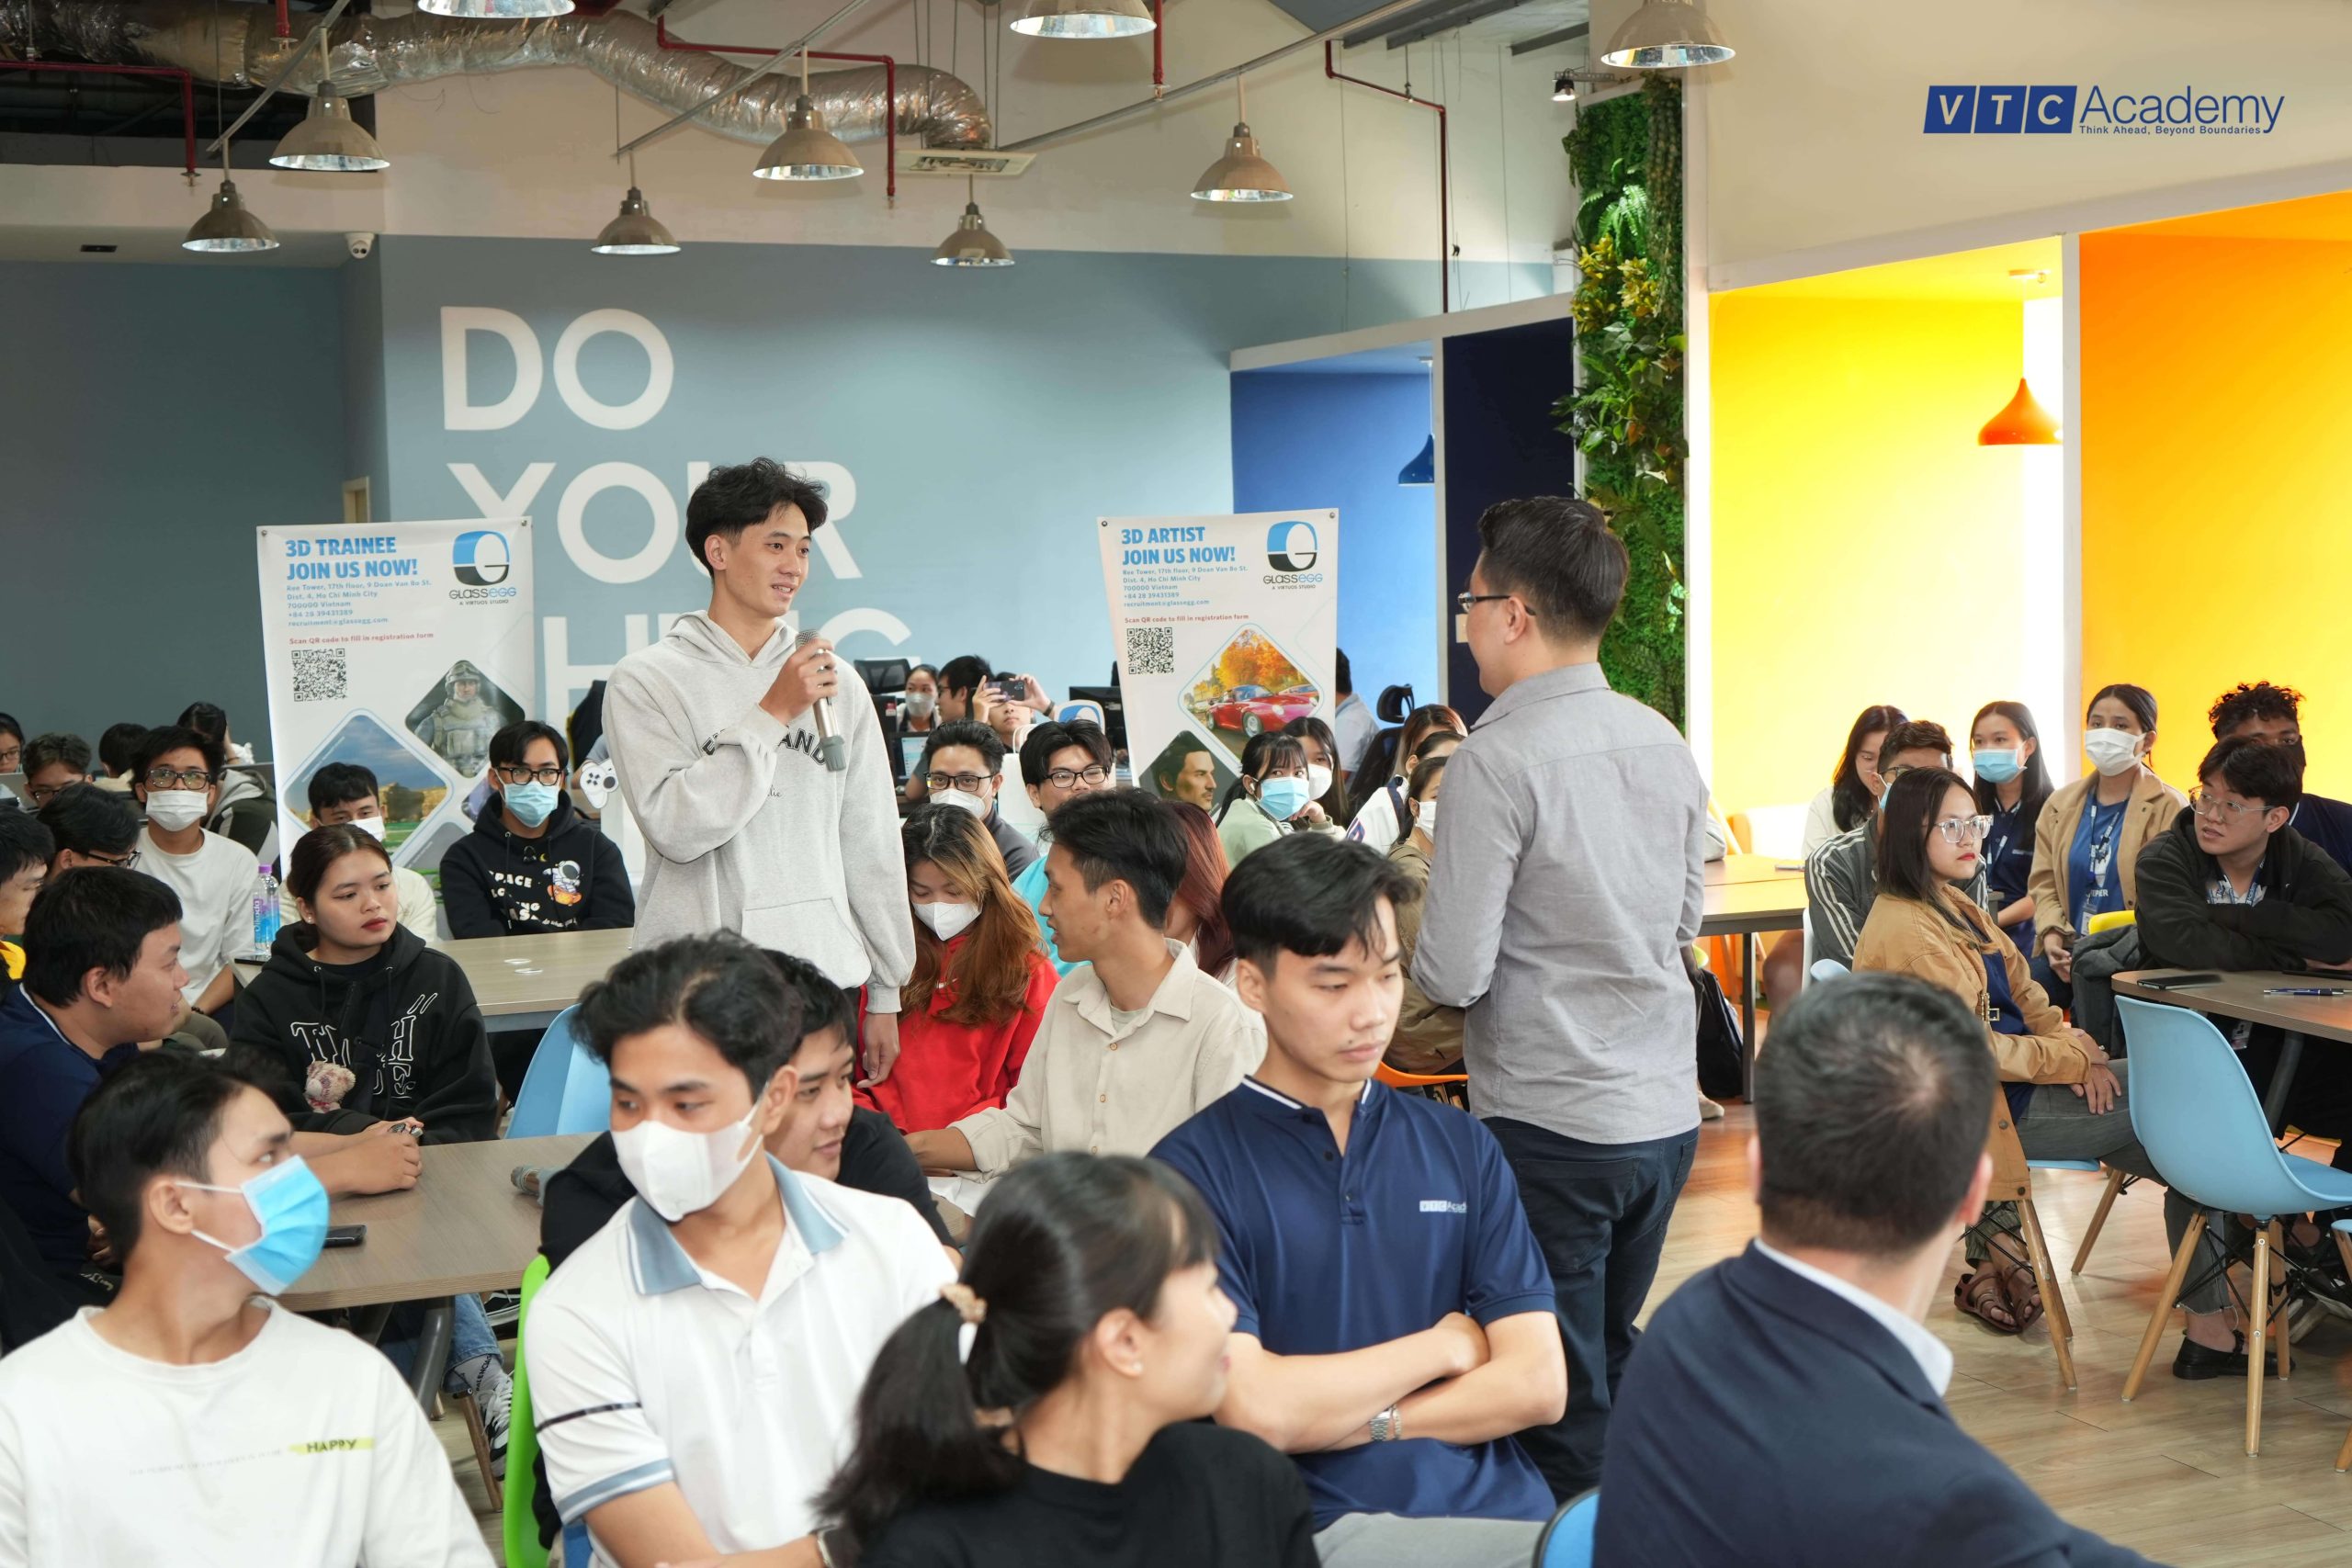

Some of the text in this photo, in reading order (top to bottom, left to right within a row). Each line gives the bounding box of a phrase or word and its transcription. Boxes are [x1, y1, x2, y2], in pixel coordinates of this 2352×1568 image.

[440, 306, 674, 431] DO
[447, 461, 863, 584] YOR
[1121, 526, 1205, 545] 3D ARTIST
[285, 536, 397, 558] 3D TRAINEE
[1122, 547, 1236, 566] JOIN US NOW!
[287, 558, 418, 581] JOIN US NOW!
[371, 633, 414, 642] registration
[489, 870, 533, 888] PACE
[306, 1438, 356, 1453] HAPPY
